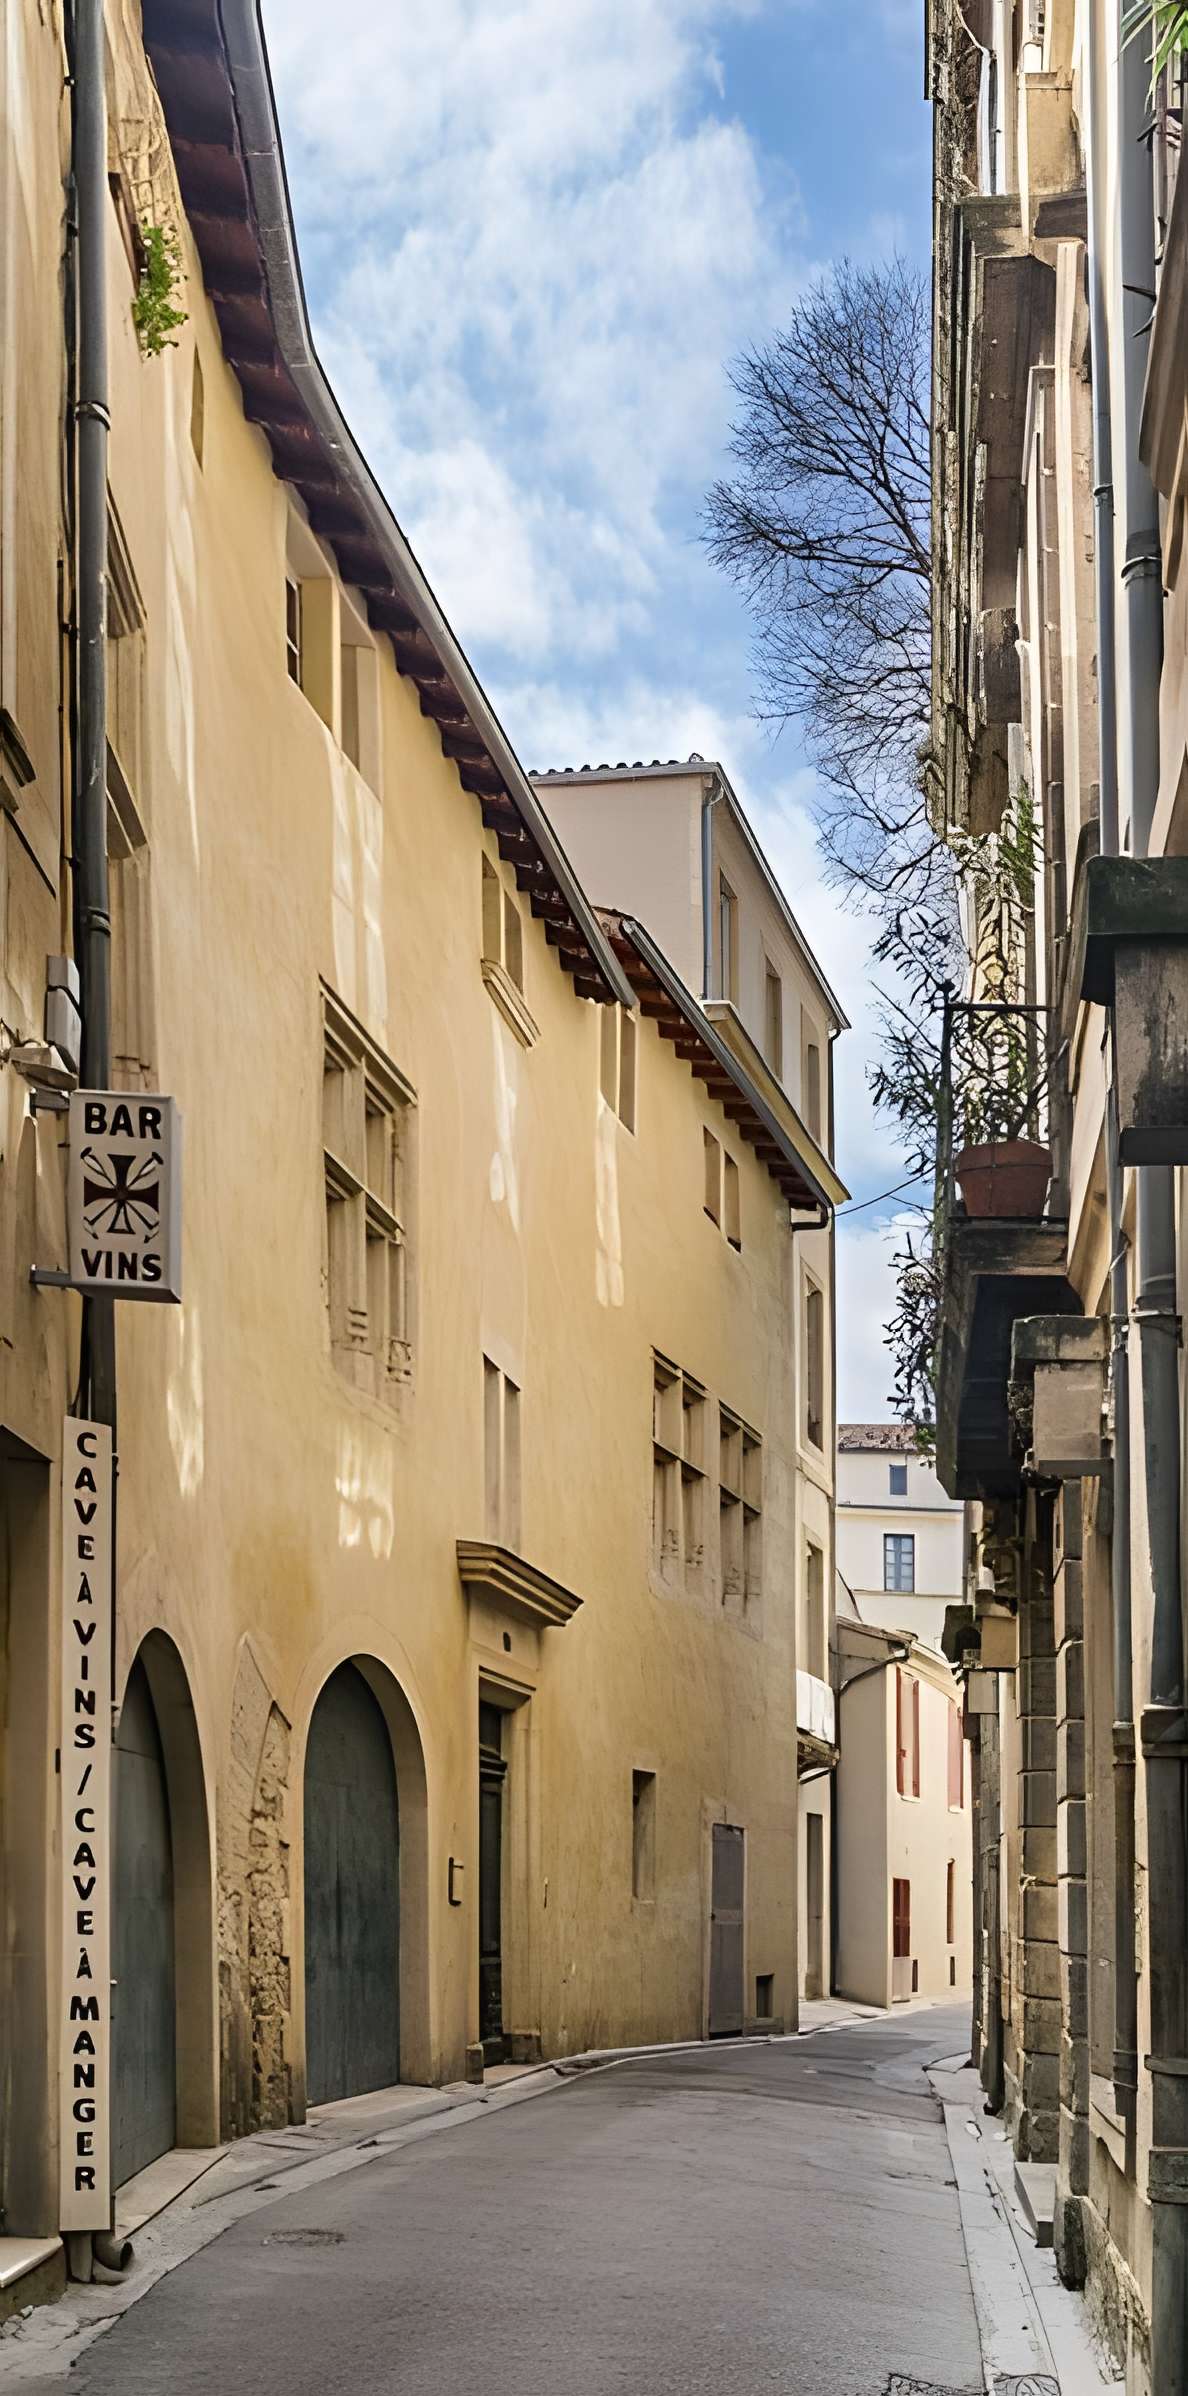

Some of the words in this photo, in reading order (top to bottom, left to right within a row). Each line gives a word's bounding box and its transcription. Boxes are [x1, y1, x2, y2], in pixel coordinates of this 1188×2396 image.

[84, 1102, 162, 1140] BAR
[80, 1248, 163, 1282] VINS
[73, 1431, 98, 1561] CAVE
[73, 1619, 97, 1749] VINS
[73, 1807, 96, 1936] CAVE
[69, 1995, 100, 2192] MANGER
